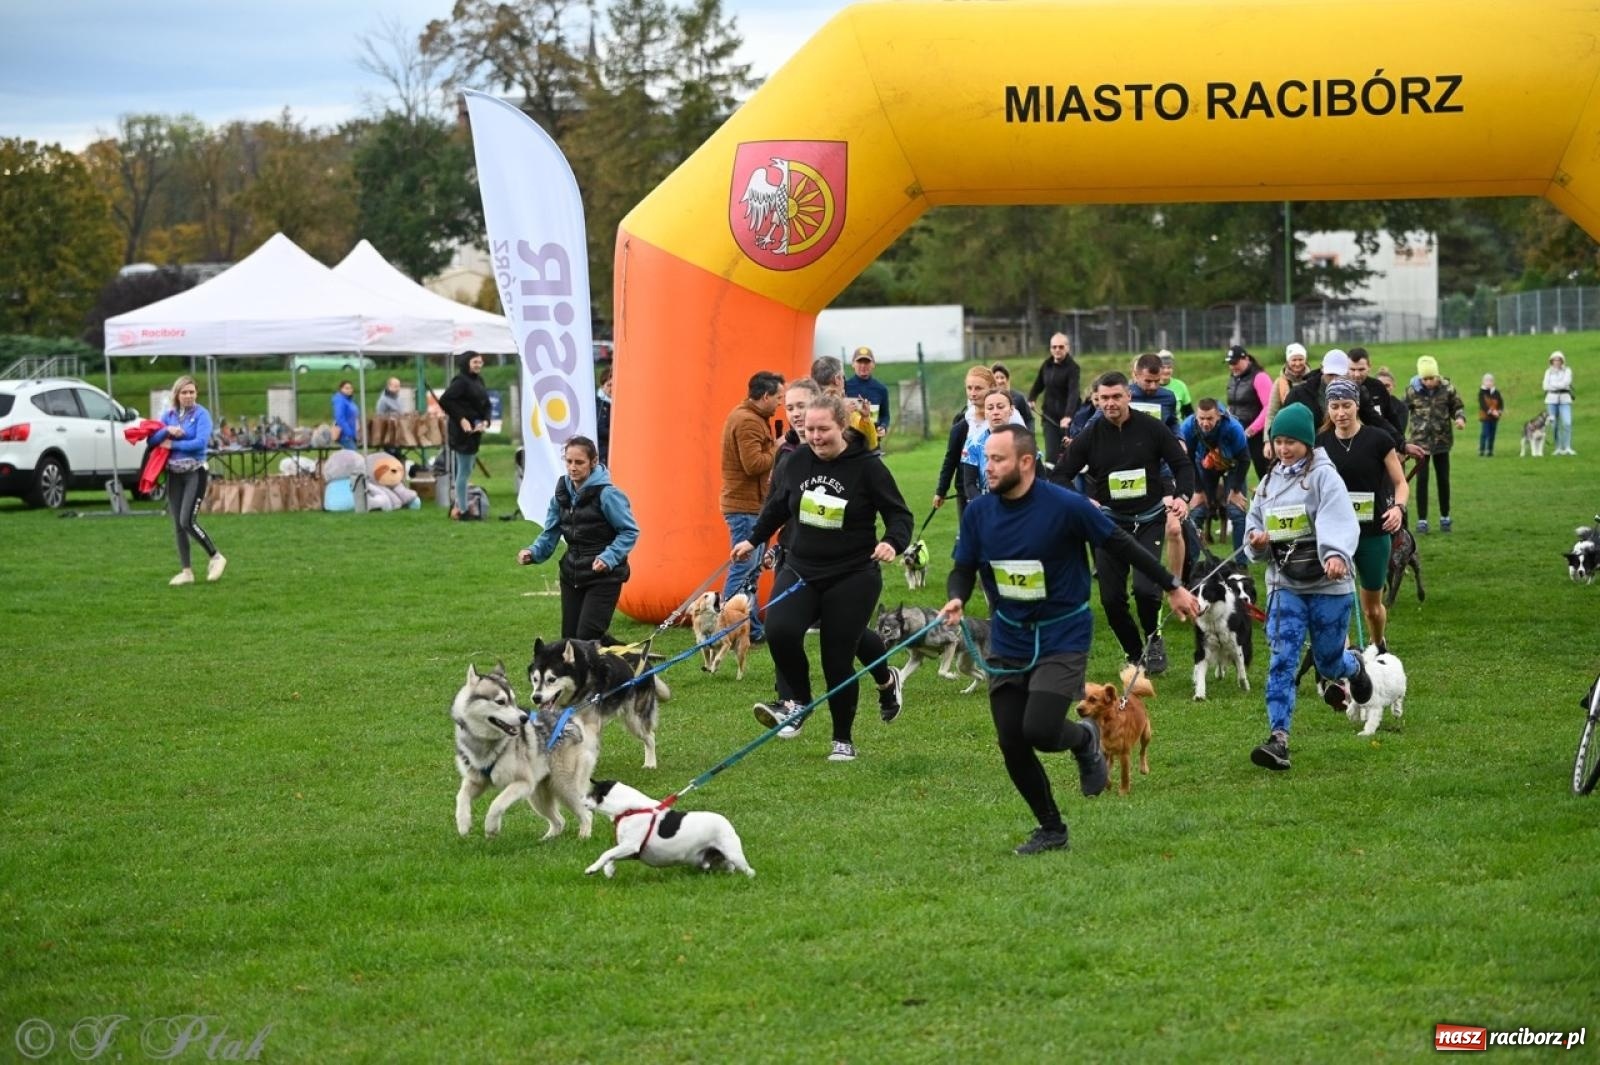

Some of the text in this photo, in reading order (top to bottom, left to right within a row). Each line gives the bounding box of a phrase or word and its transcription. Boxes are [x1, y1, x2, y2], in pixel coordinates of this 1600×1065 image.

[1005, 69, 1464, 122] MIASTO RACIBÓRZ
[800, 475, 845, 493] FEARLESS
[1120, 479, 1135, 489] 27
[818, 505, 826, 515] 3
[1278, 517, 1294, 529] 37
[1009, 574, 1027, 586] 12
